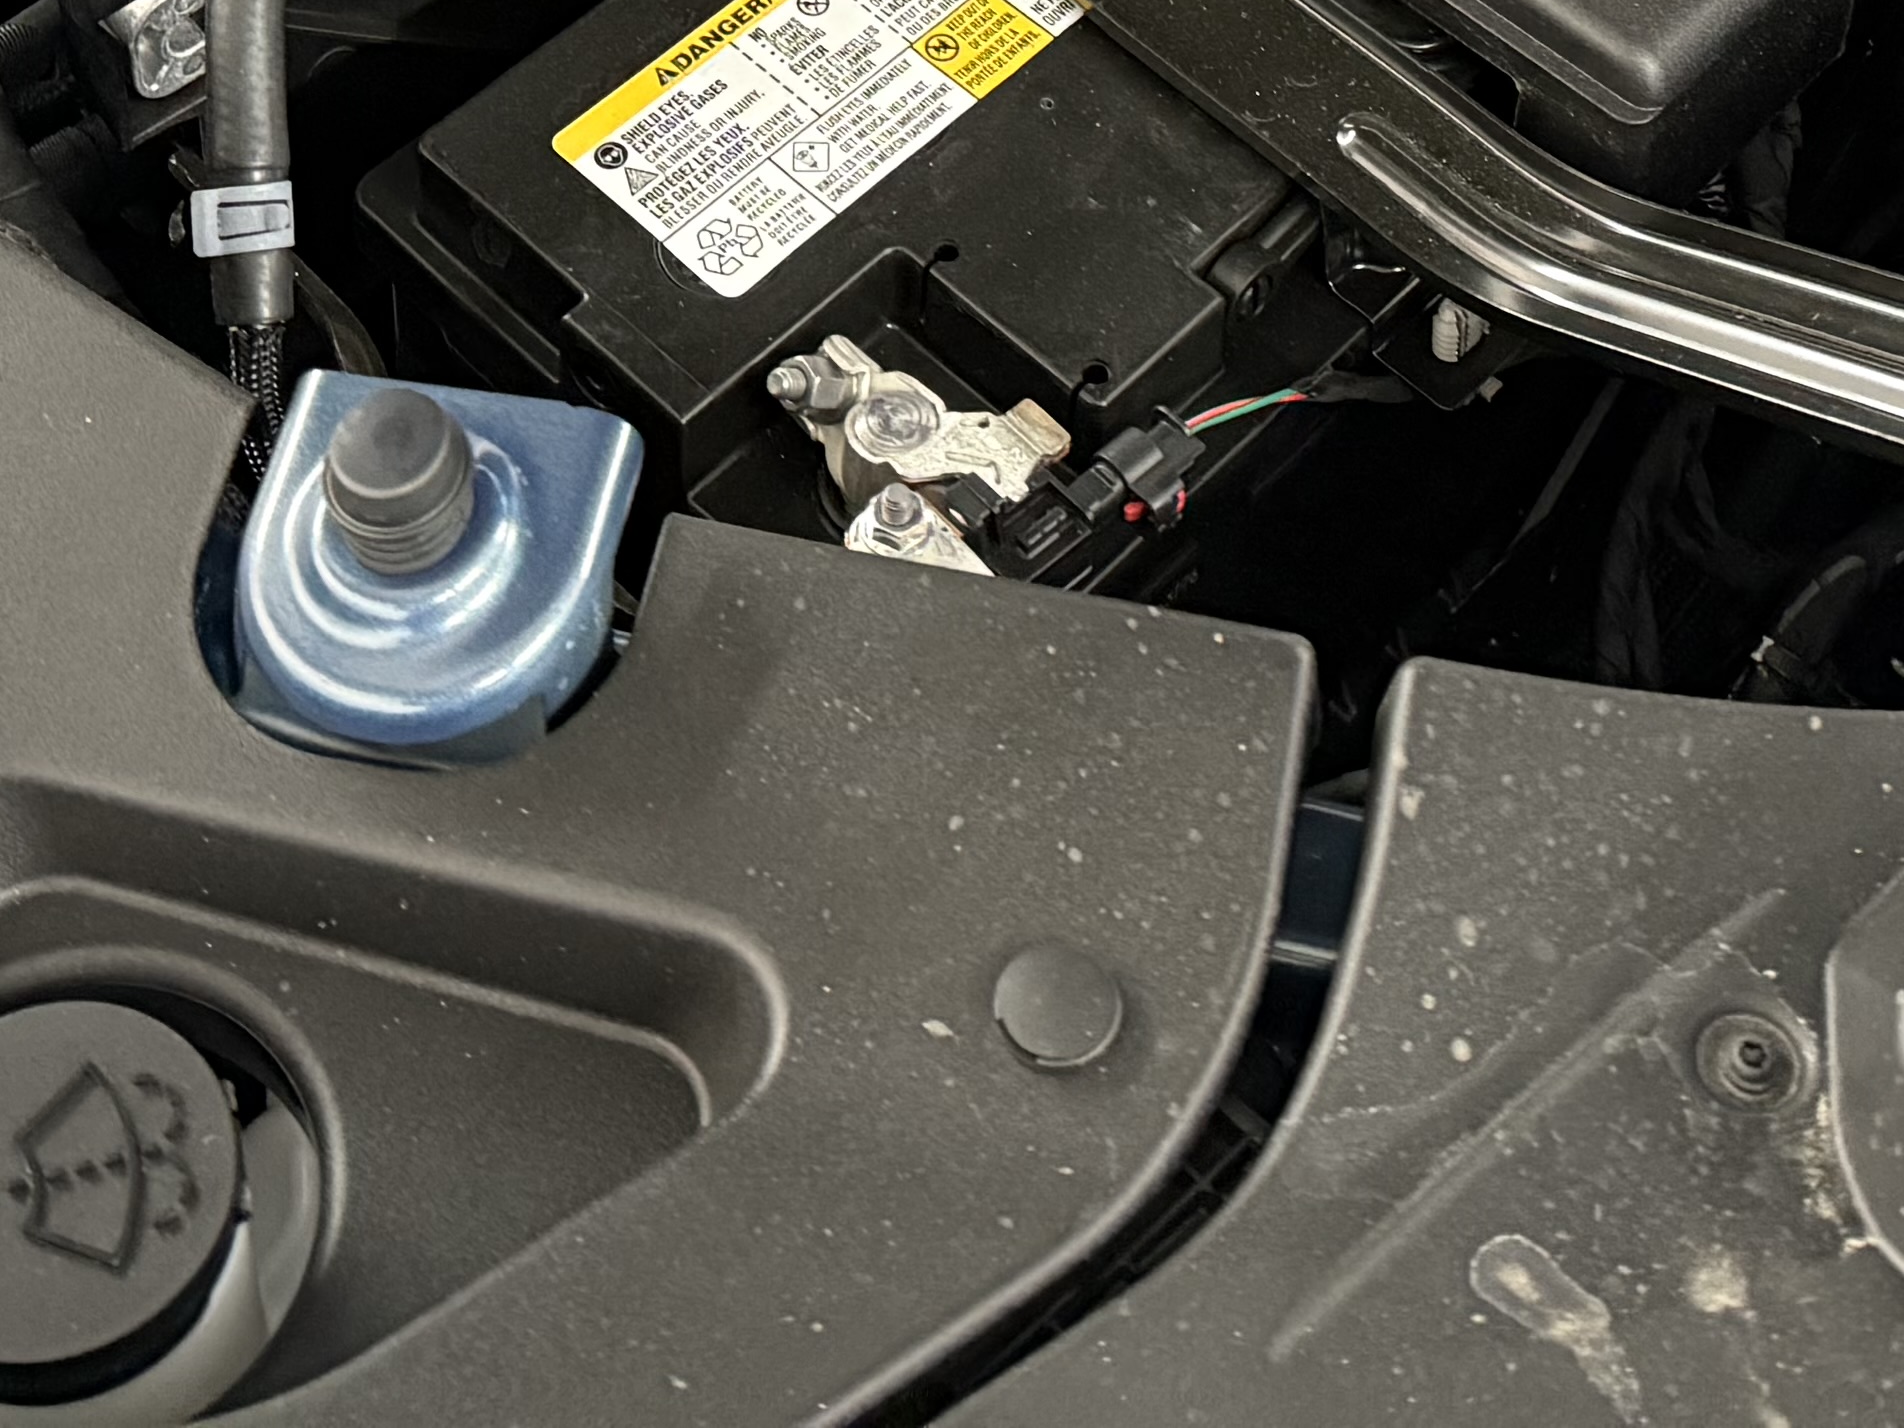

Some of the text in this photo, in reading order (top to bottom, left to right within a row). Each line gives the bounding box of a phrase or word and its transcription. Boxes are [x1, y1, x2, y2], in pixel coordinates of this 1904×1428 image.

[747, 26, 768, 42] NO
[764, 16, 801, 45] SPARKS
[893, 4, 922, 27] PEUT
[904, 20, 924, 36] OU
[918, 6, 942, 25] DES
[944, 13, 968, 32] KEEP
[960, 1, 982, 19] OUT
[955, 7, 998, 41] THE REACH
[1003, 26, 1020, 40] LA
[782, 26, 827, 61] SMOKING
[785, 41, 830, 76] ÉVITER
[807, 23, 880, 81] LES ÉTINCELLES
[966, 37, 983, 50] OF
[817, 37, 883, 89] LES FLAMMES
[827, 58, 877, 98] DE FUMER
[814, 57, 913, 135] FLUSH EYES IMMEDIATELY
[619, 87, 694, 145] SHIELD EYES.
[630, 78, 729, 154] EXPLOSIVE GASES
[653, 86, 766, 174] BLINDNESS OR INJURY.
[826, 122, 853, 145] WITH
[837, 136, 859, 154] GET
[853, 111, 891, 141] MEDICAL
[885, 94, 911, 115] HELP
[642, 118, 702, 164] CAN CAUSE
[633, 119, 751, 209] PROTÉGEZ LES YEUX.
[648, 102, 798, 219] LES GAZ EXPLOSIFS PEUVENT
[660, 112, 809, 229] BLESSER OU RENDRE AVEUGLE.
[716, 235, 739, 254] Pb
